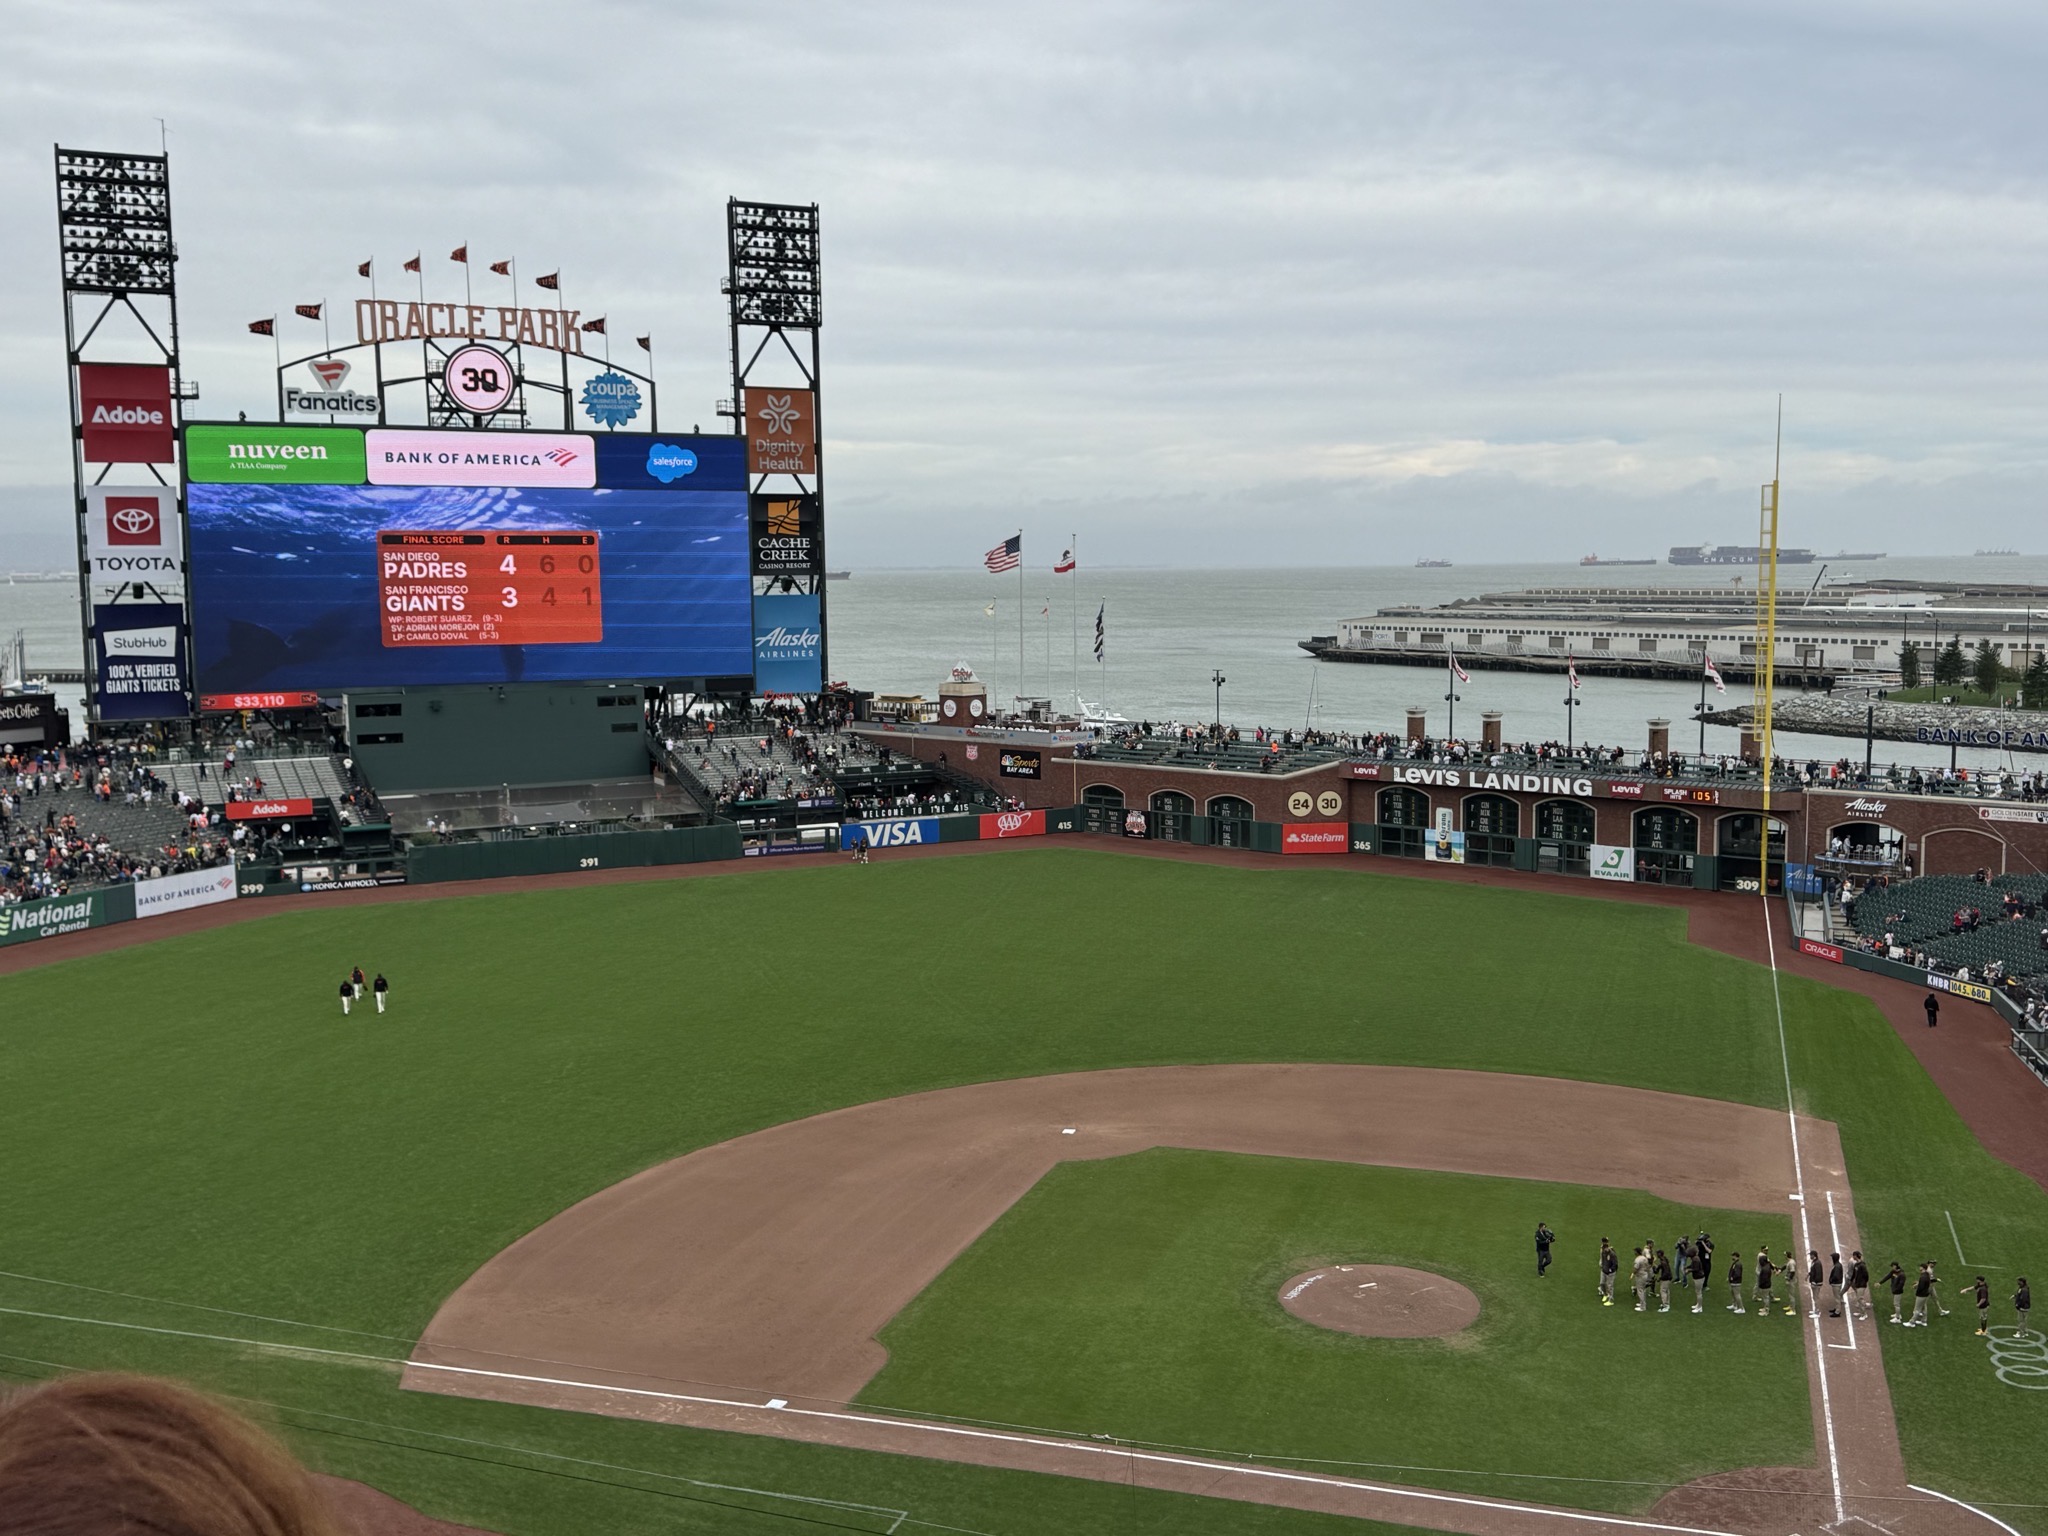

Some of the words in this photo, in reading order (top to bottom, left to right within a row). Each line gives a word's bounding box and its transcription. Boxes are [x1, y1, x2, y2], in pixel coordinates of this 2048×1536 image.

[356, 300, 486, 345] ORACLE
[498, 307, 584, 356] PARK
[589, 383, 636, 399] coupa
[285, 391, 377, 413] Fanatics
[91, 405, 163, 425] Adobe
[228, 444, 328, 461] nuveen
[756, 438, 805, 457] Dignity
[385, 451, 433, 465] BANK
[438, 452, 460, 465] OF
[464, 453, 541, 467] AMERICA
[653, 457, 693, 467] salesforce
[759, 456, 804, 470] Health
[255, 463, 287, 471] Company
[403, 535, 430, 544] FINAL
[432, 535, 464, 544] SCORE
[503, 536, 510, 544] R
[542, 536, 550, 544] H
[582, 536, 588, 544] E
[758, 536, 811, 549] CACHE
[383, 552, 406, 562] SAN
[408, 552, 440, 562] DIEGO
[760, 549, 809, 561] CREEK
[95, 557, 175, 571] TOYOTA
[384, 562, 467, 578] PADRES
[499, 554, 517, 575] 4
[540, 555, 555, 574] 6
[578, 555, 594, 574] 0
[385, 585, 408, 595] SAN
[410, 585, 469, 595] FRANCISCO
[386, 595, 465, 613] GIANTS
[501, 586, 518, 608] 3
[542, 586, 557, 606] 4
[582, 586, 592, 606] 1
[405, 615, 438, 623] ROBERT
[482, 614, 503, 623] (9-3)
[391, 624, 405, 632] SV:
[406, 624, 437, 632] ADRIAN
[438, 623, 480, 631] MOREJON
[483, 622, 494, 631] (2)
[113, 636, 167, 649] StubHub
[392, 633, 405, 641] LP:
[406, 633, 439, 641] CAMILO
[440, 632, 469, 640] DOVAL
[479, 632, 499, 640] (5-3)
[755, 626, 818, 648] Alaska
[759, 649, 814, 658] AIRLINES
[107, 664, 134, 679] 100%
[136, 663, 176, 678] VERIFIED
[106, 680, 140, 694] GIANTS
[142, 678, 181, 693] TICKETS
[234, 695, 285, 708] $33,110
[15, 703, 40, 720] Coffee
[1918, 727, 1979, 744] BANK
[1986, 730, 2015, 744] OF
[1013, 756, 1040, 768] Sports
[1469, 771, 1593, 797] LANDING
[1664, 788, 1687, 796] SPLASH
[1692, 791, 1711, 800] 105
[252, 804, 288, 815] Adobe
[1293, 799, 1310, 810] 24
[1321, 798, 1338, 809] 30
[1844, 798, 1887, 813] Alaska
[862, 808, 904, 818] WELCOME
[931, 805, 945, 813] THE
[953, 804, 969, 812] 415
[1000, 814, 1019, 829] AAA
[1057, 822, 1072, 830] 415
[1653, 823, 1662, 831] AZ
[860, 821, 923, 847] VISA
[1653, 832, 1661, 840] LA
[1353, 841, 1371, 850] 365
[1651, 840, 1663, 849] ATL
[579, 857, 598, 868] 391
[240, 883, 264, 895] 399
[312, 881, 346, 891] KONICA
[347, 879, 378, 888] MINOLTA
[1736, 879, 1759, 891] 309
[137, 896, 162, 906] BANK
[164, 891, 175, 901] OF
[177, 884, 215, 898] AMERICA
[12, 898, 92, 931] National
[40, 924, 57, 937] Car
[59, 919, 89, 934] Rental
[1805, 943, 1837, 959] ORACLE
[1927, 974, 1949, 990] KNBR
[1971, 987, 1986, 999] 680
